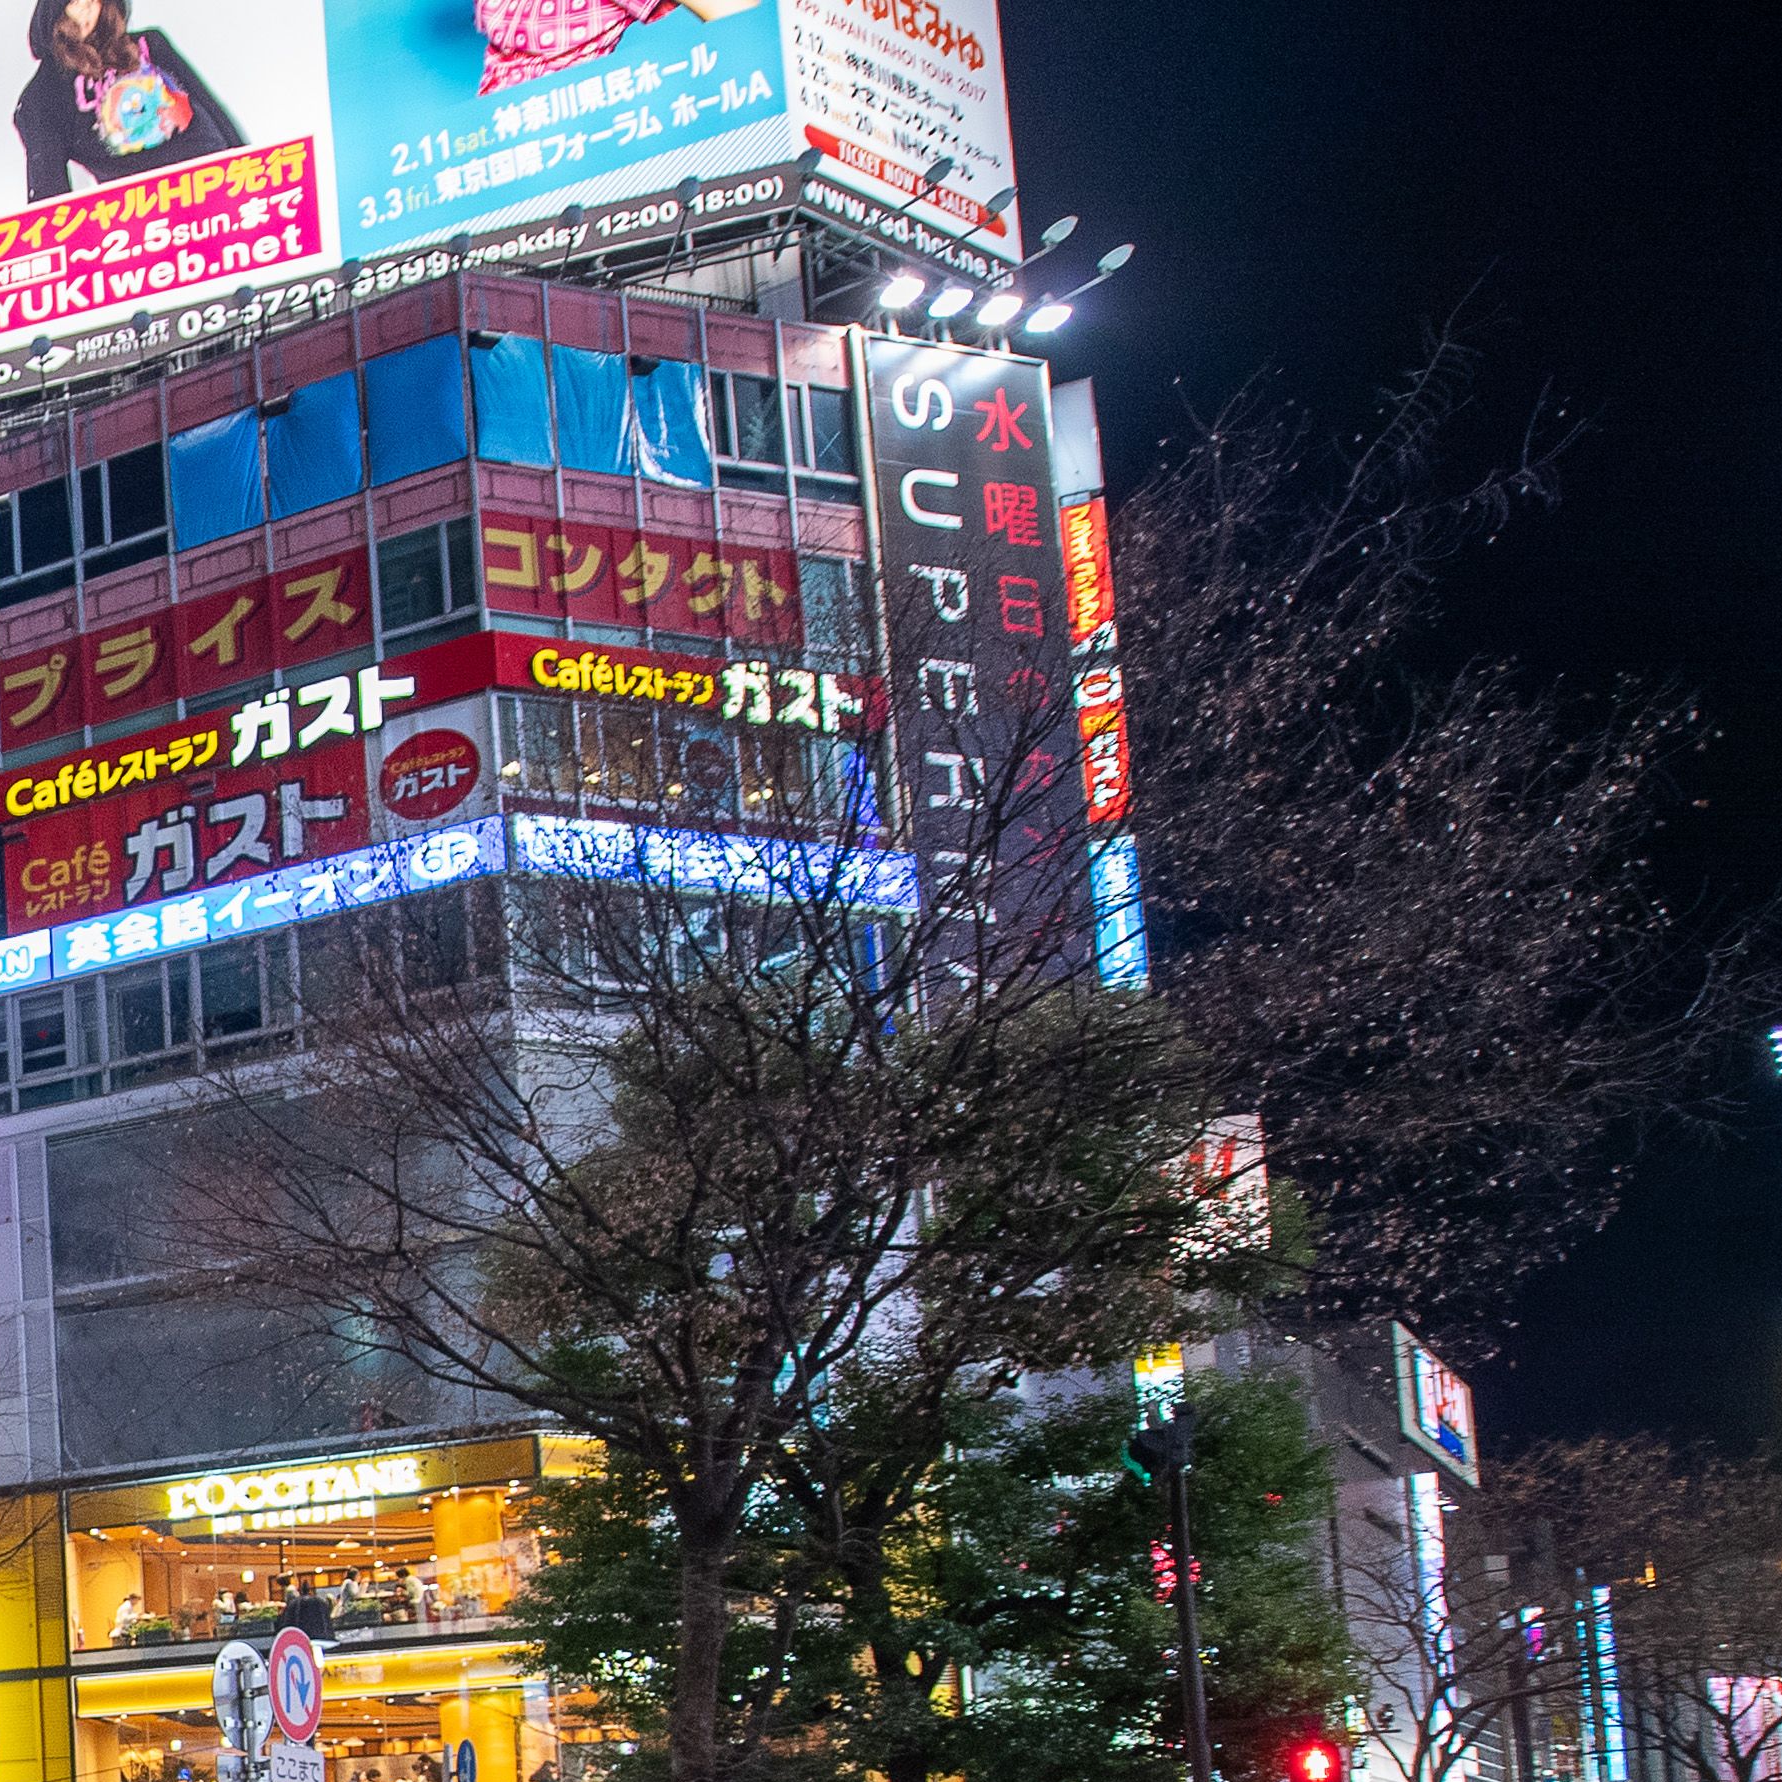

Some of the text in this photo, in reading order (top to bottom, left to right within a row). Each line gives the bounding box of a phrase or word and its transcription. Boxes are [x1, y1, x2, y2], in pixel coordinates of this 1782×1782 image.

[390, 43, 718, 177] 2.11 sat. 神奈川県民ホール
[921, 58, 952, 86] TOUR
[957, 77, 987, 103] 2017
[358, 186, 404, 229] 3.3
[434, 111, 662, 204] 東京国際フォーラム
[671, 70, 773, 127] ホールA
[837, 140, 882, 178] TICKET
[884, 163, 915, 193] NOW
[595, 175, 783, 239] 12:0018:00)
[484, 527, 787, 620] コンタクト
[4, 566, 355, 727] プライス
[532, 649, 863, 733] Caféレストラン ガスト
[6, 666, 415, 816] Caféレストラン ガスト
[394, 764, 470, 800] ガスト
[21, 842, 112, 892] Café
[126, 783, 345, 900] ガスト
[26, 880, 110, 917] レストラン
[66, 859, 393, 970] 英会話イーオン
[167, 1459, 421, 1518] L'OCCITANE
